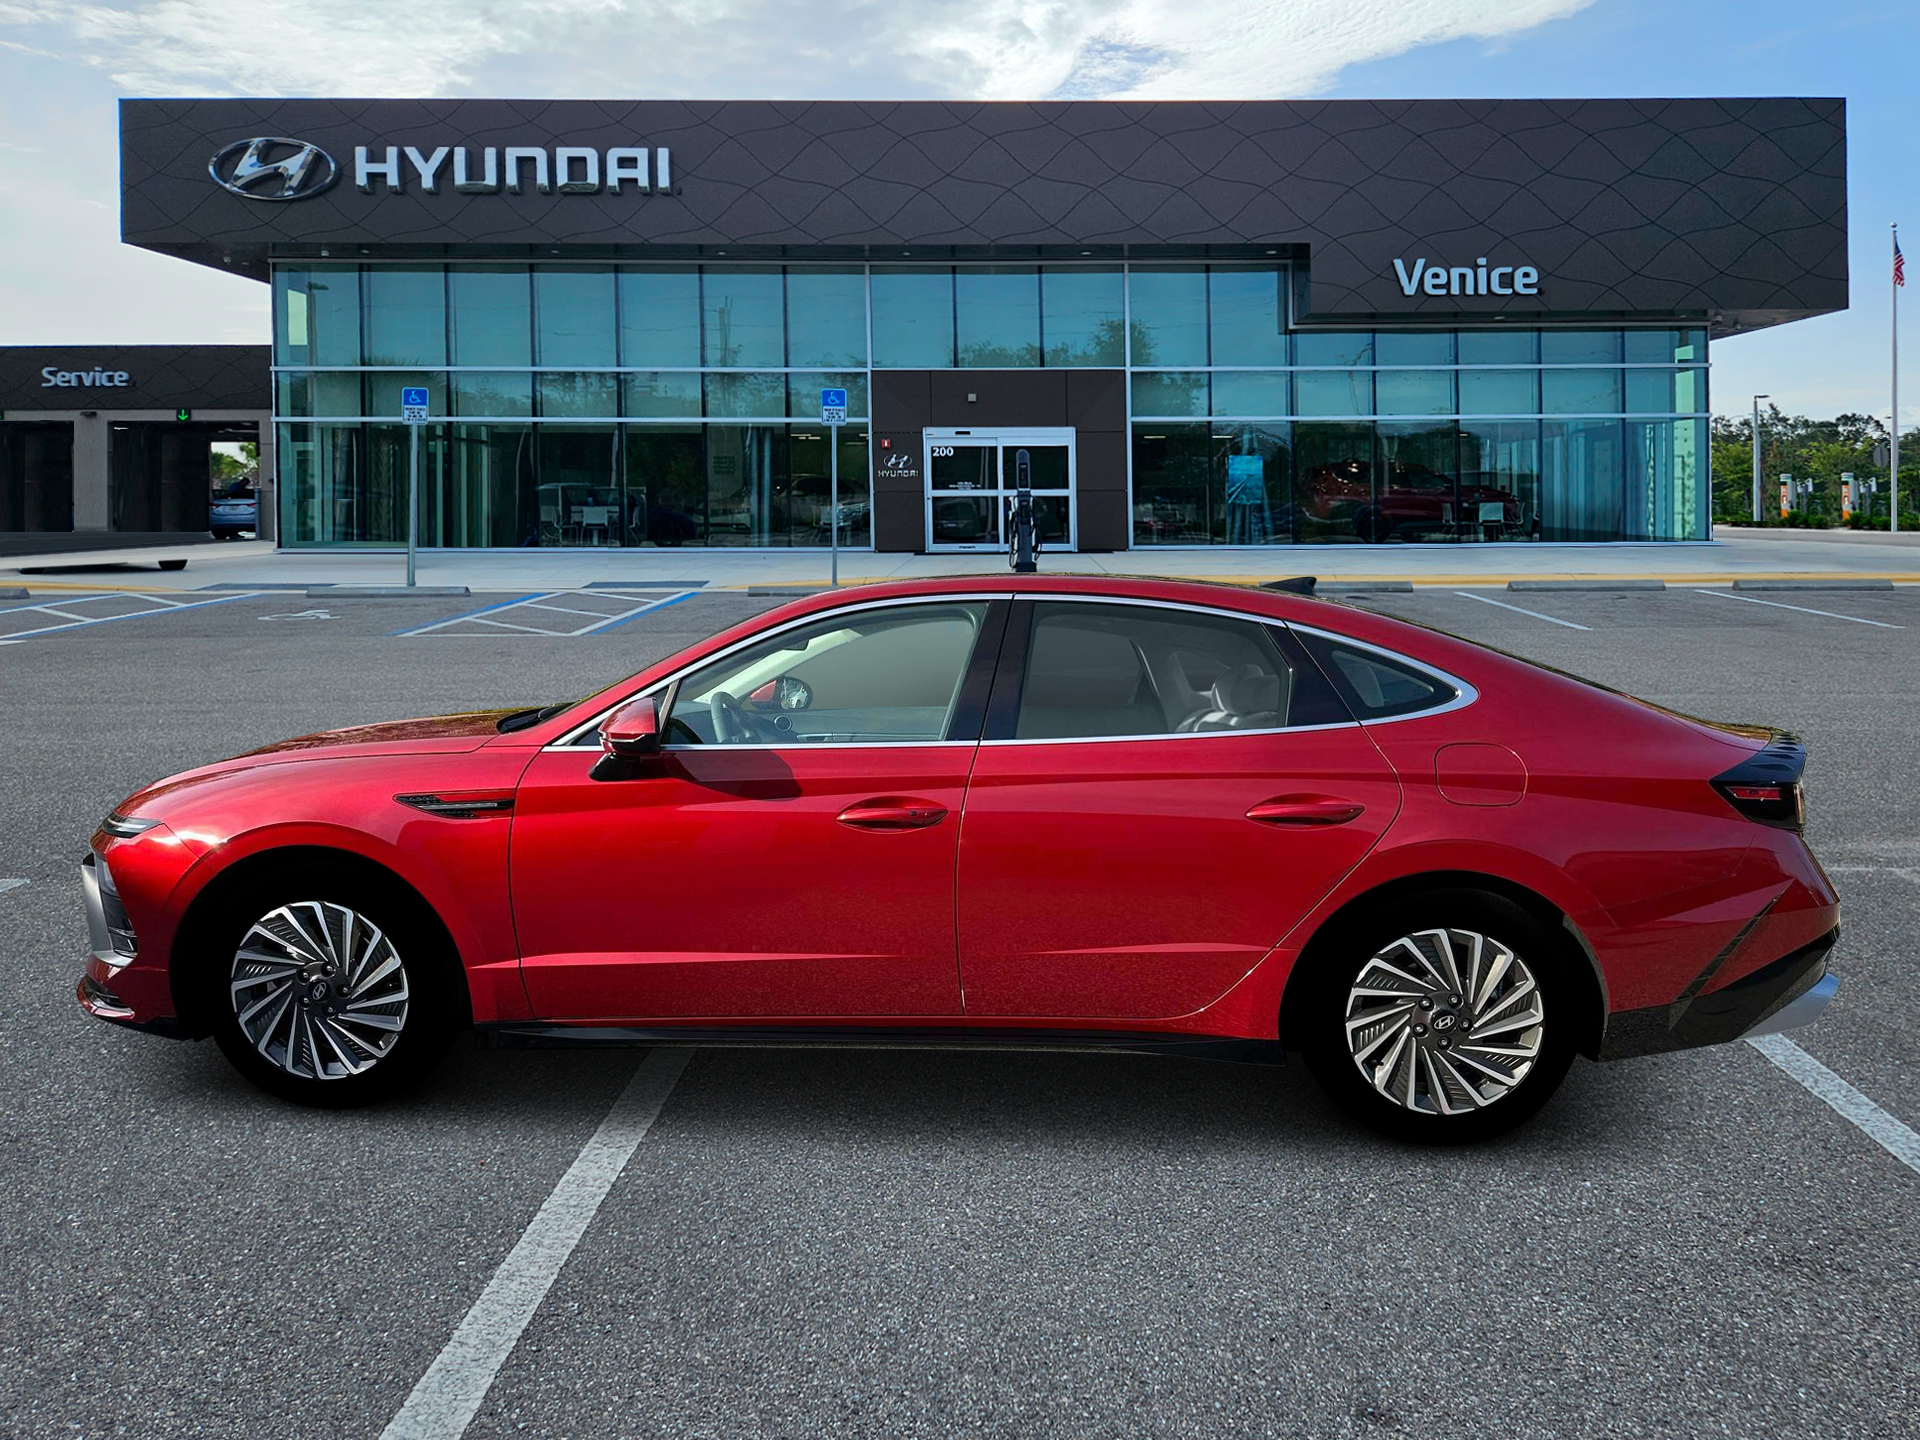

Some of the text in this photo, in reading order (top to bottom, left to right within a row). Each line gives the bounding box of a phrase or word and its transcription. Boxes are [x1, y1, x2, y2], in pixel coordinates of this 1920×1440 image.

[354, 146, 671, 194] HYUNDAI
[1392, 257, 1539, 296] Venice
[41, 366, 130, 387] Service
[932, 446, 954, 457] 200
[878, 469, 919, 478] HYUNDAI
